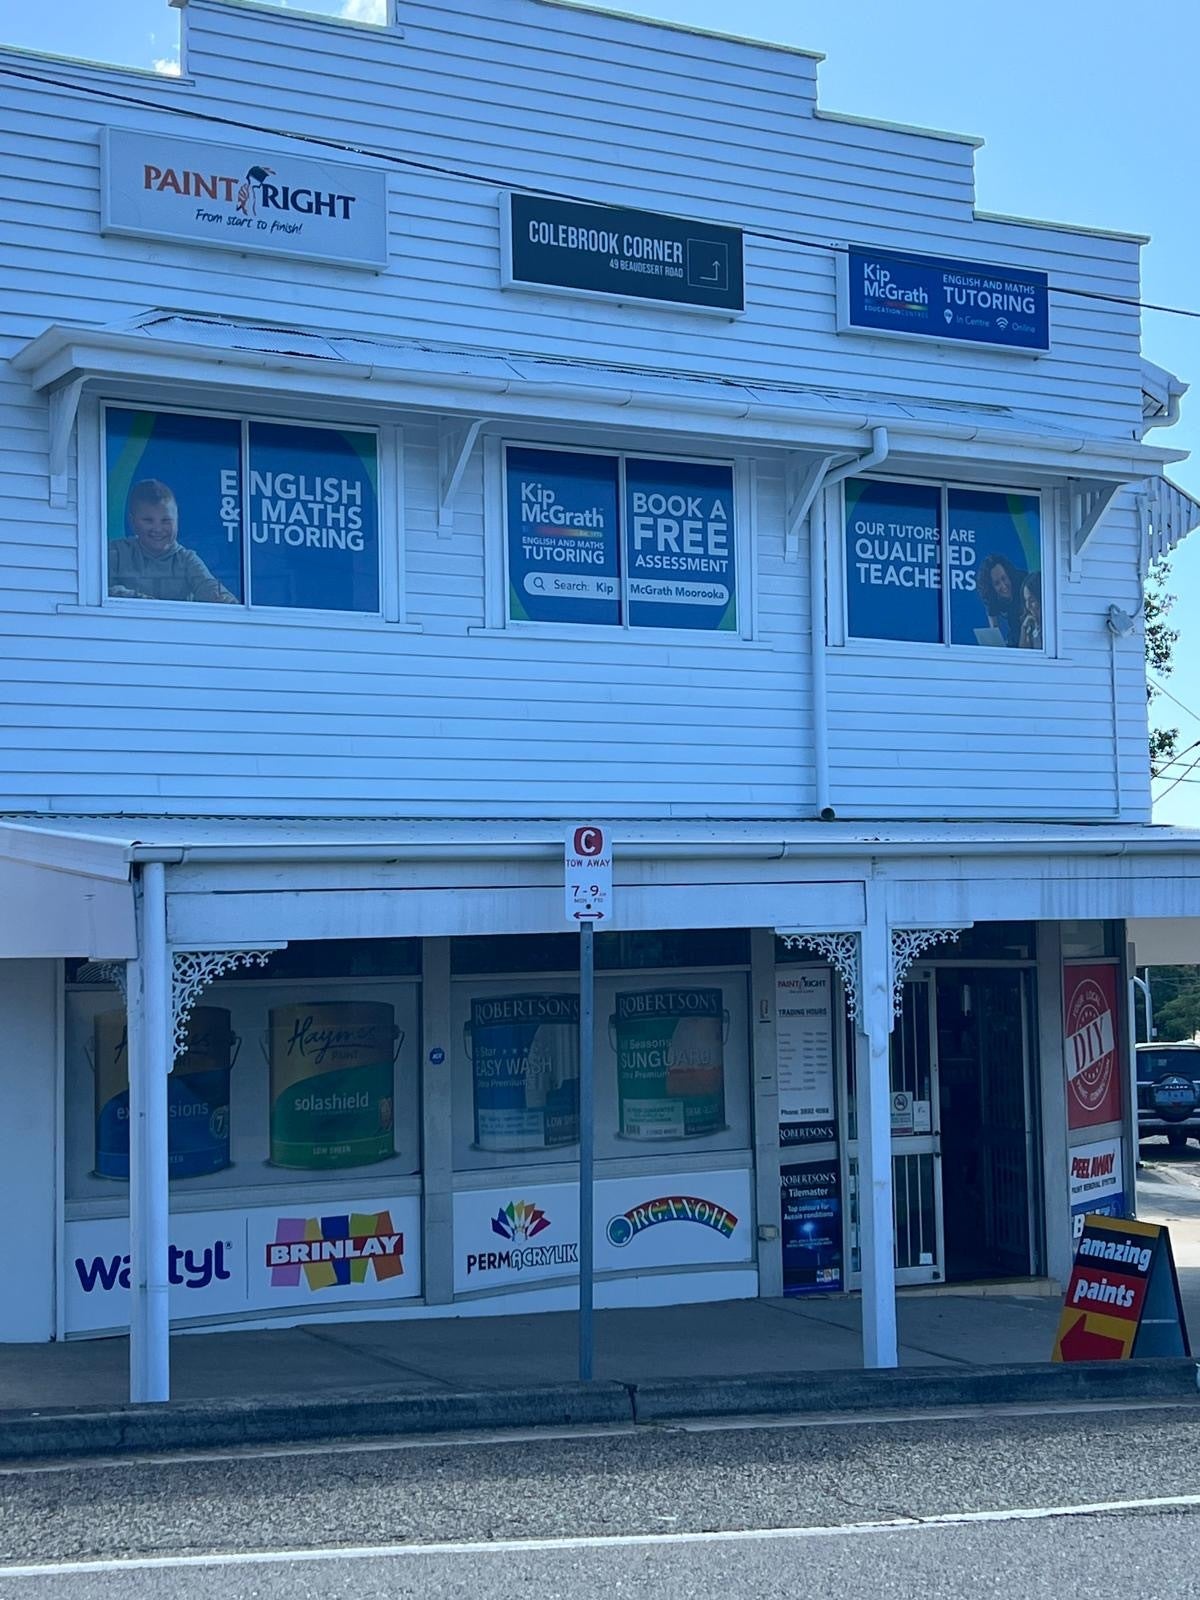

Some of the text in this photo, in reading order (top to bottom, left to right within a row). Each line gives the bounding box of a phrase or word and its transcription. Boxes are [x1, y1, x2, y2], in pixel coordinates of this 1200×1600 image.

[143, 164, 356, 220] PAINT RIGHT
[195, 208, 302, 235] From start to finish!
[528, 220, 683, 264] COLEBROOK CORNER
[609, 259, 684, 278] 49 BEAUDESERT ROAD
[863, 263, 890, 287] Kip
[864, 281, 928, 304] McGrath
[942, 274, 1035, 295] ENGLISH AND MATHS
[943, 286, 1035, 314] TUTORING
[220, 469, 362, 505] ENGLISH
[521, 482, 555, 510] Kip
[220, 496, 363, 530] & MATHS
[521, 503, 604, 528] McGrath
[632, 492, 727, 520] BOOK A
[222, 522, 364, 551] TUTORING
[522, 536, 604, 550] ENGLISH AND MATHS
[633, 516, 729, 557] FREE
[855, 521, 976, 543] OUR TUTORS ARE
[522, 545, 604, 564] TUTORING
[635, 554, 728, 573] ASSESSMENT
[855, 538, 976, 566] QUALIFIED
[554, 579, 725, 600] Search: Kip McGrath Moorooka
[855, 562, 977, 591] TEACHERS
[581, 830, 596, 853] C
[566, 859, 610, 867] TOW AWAY
[619, 992, 718, 1018] ROBERTSON'S
[1073, 1017, 1104, 1073] DIY
[294, 1092, 369, 1111] solashield
[779, 1127, 834, 1140] ROBERTSON'S
[1071, 1152, 1115, 1179] PEEL AWAY
[780, 1173, 836, 1186] ROBERTSON'S
[270, 1235, 400, 1265] BRINLAY
[467, 1243, 578, 1275] PERMACRYLIK
[1079, 1238, 1153, 1272] amazing
[75, 1240, 231, 1292] watyl
[1072, 1278, 1135, 1308] paints
